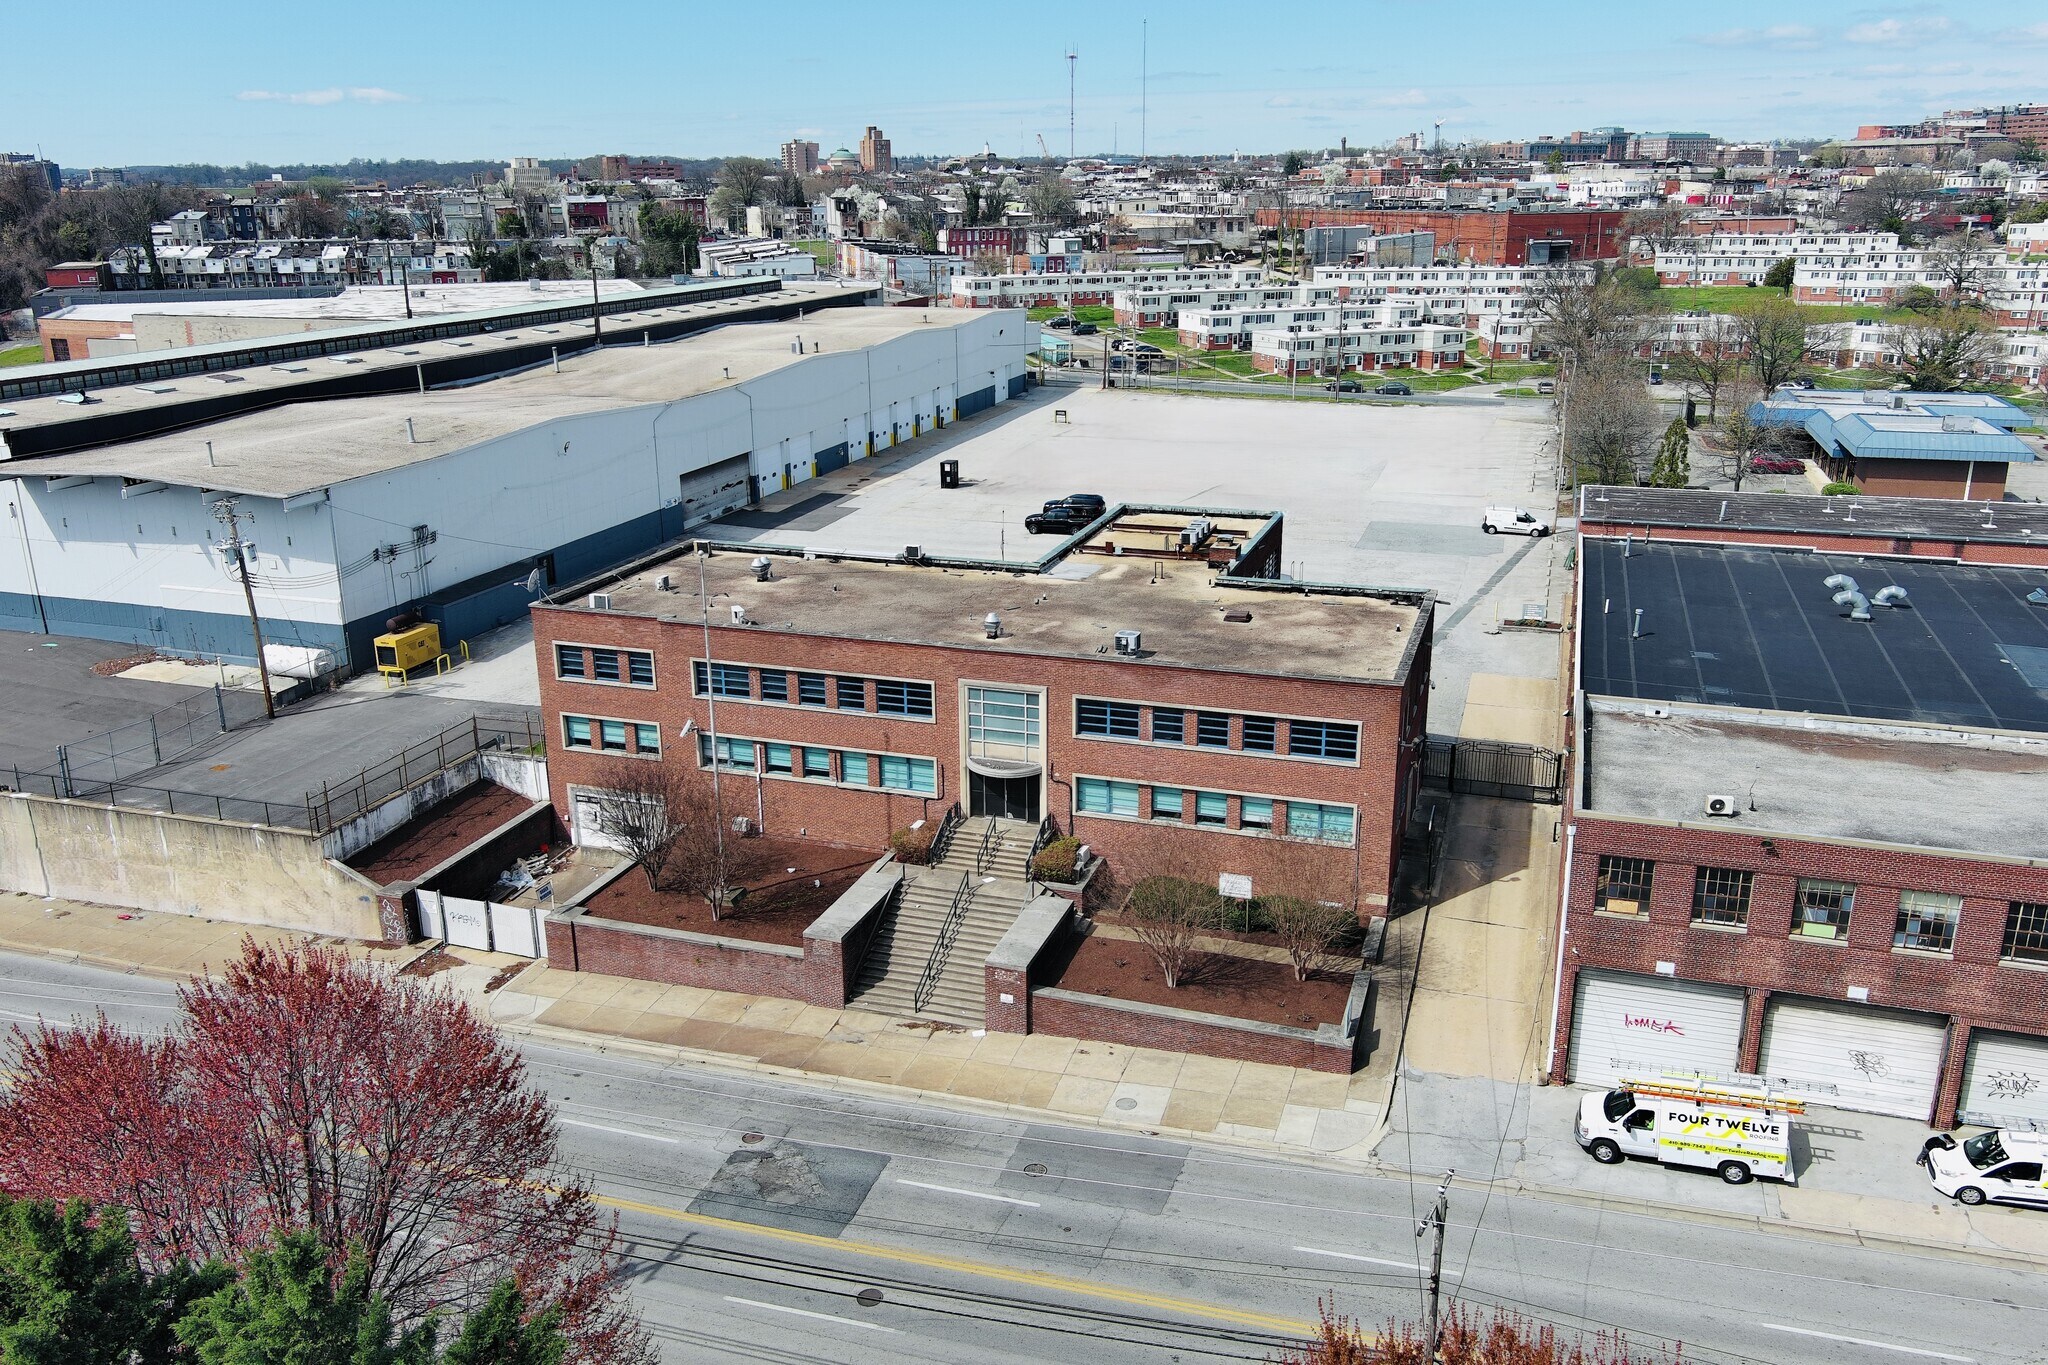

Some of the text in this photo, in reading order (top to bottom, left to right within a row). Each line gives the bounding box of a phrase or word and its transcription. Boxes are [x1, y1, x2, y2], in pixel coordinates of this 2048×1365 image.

[1669, 1112, 1779, 1135] FOUR TWELVE
[1749, 1134, 1779, 1142] ROOFING
